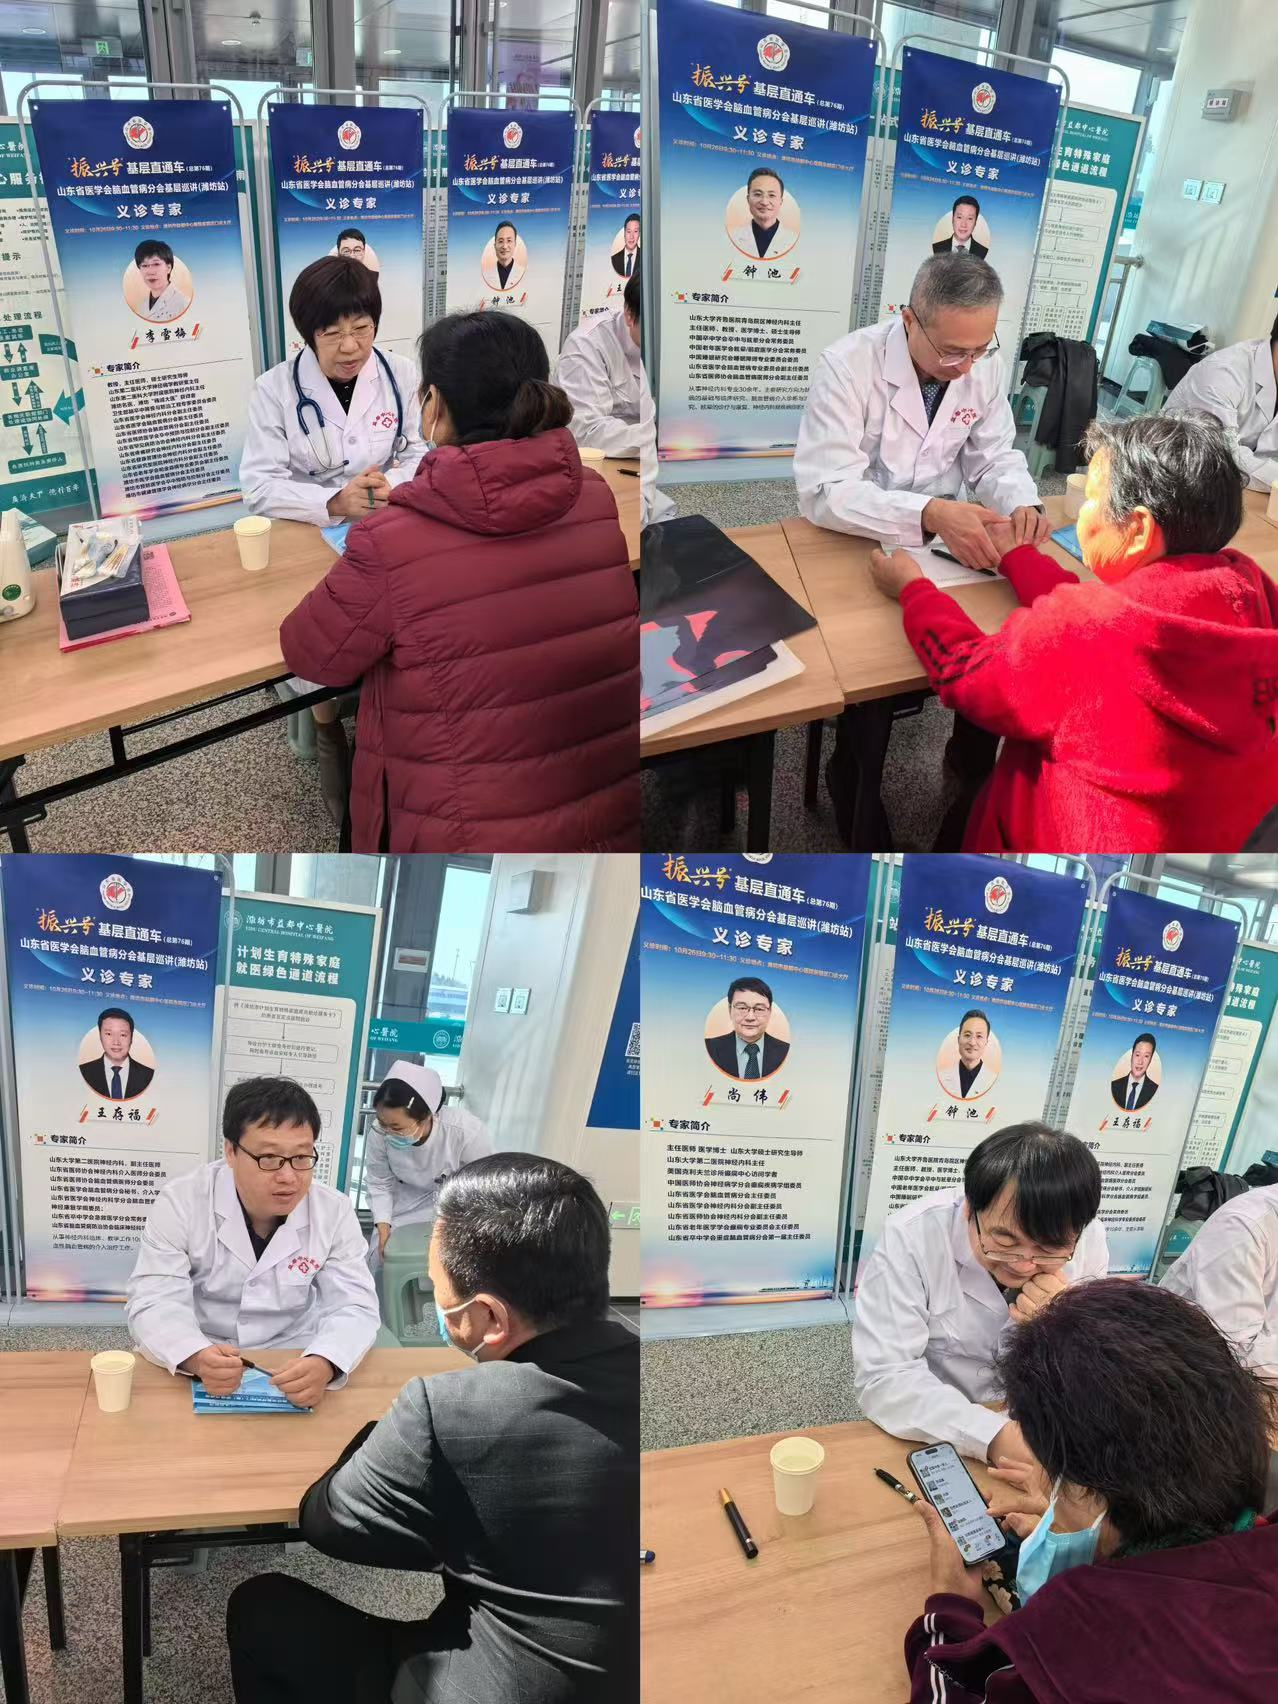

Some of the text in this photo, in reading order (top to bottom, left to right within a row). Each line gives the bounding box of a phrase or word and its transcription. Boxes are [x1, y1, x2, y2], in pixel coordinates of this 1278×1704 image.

[754, 81, 815, 105] 基层直通车
[733, 126, 804, 150] 义诊专家
[965, 123, 1011, 142] 基层直通车
[127, 161, 184, 174] 基层直通车
[338, 160, 382, 172] 基层直通车
[501, 159, 537, 169] 基层直通车
[946, 161, 1000, 180] 义诊专家
[487, 193, 530, 205] 义诊专家
[619, 188, 640, 199] 义诊
[326, 197, 377, 210] 义诊专家
[117, 204, 182, 219] 义诊专家
[743, 265, 781, 279] 钟池
[692, 293, 729, 303] 专家简介
[4, 311, 43, 321] 处理流程
[145, 328, 187, 342] 李雪梅
[107, 362, 140, 372] 专家简介
[735, 875, 805, 904] 基层直通车
[641, 886, 853, 939] 山东省医学会脑血管病分会基层巡讲(潍坊站)
[98, 922, 161, 944] 基层直通车
[976, 924, 1029, 948] 基层直通车
[712, 927, 793, 956] 义诊专家
[237, 945, 341, 969] 计划生育特殊家庭
[236, 962, 339, 985] 就医绿色通道流程
[1153, 959, 1192, 980] 基层直通车
[81, 967, 153, 989] 义诊专家
[953, 969, 1014, 992] 义诊专家
[1132, 999, 1178, 1017] 义诊专家
[727, 1088, 768, 1105] 尚伟
[97, 1107, 140, 1121] 王存福
[946, 1106, 979, 1118] 钟池
[668, 1119, 710, 1131] 专家简介
[1113, 1116, 1141, 1128] 王存福
[50, 1134, 87, 1145] 专家简介
[899, 1134, 930, 1144] 专家简介
[667, 1144, 803, 1157] 主任医师 医学博士 山东大学硕士研究生导师
[667, 1156, 764, 1166] 山东大学第二医院神经内科主任
[668, 1191, 776, 1199] 山东省医学会脑血管病分会主任委员
[668, 1202, 782, 1210] 山东省医学会神经内科分会副主任委员
